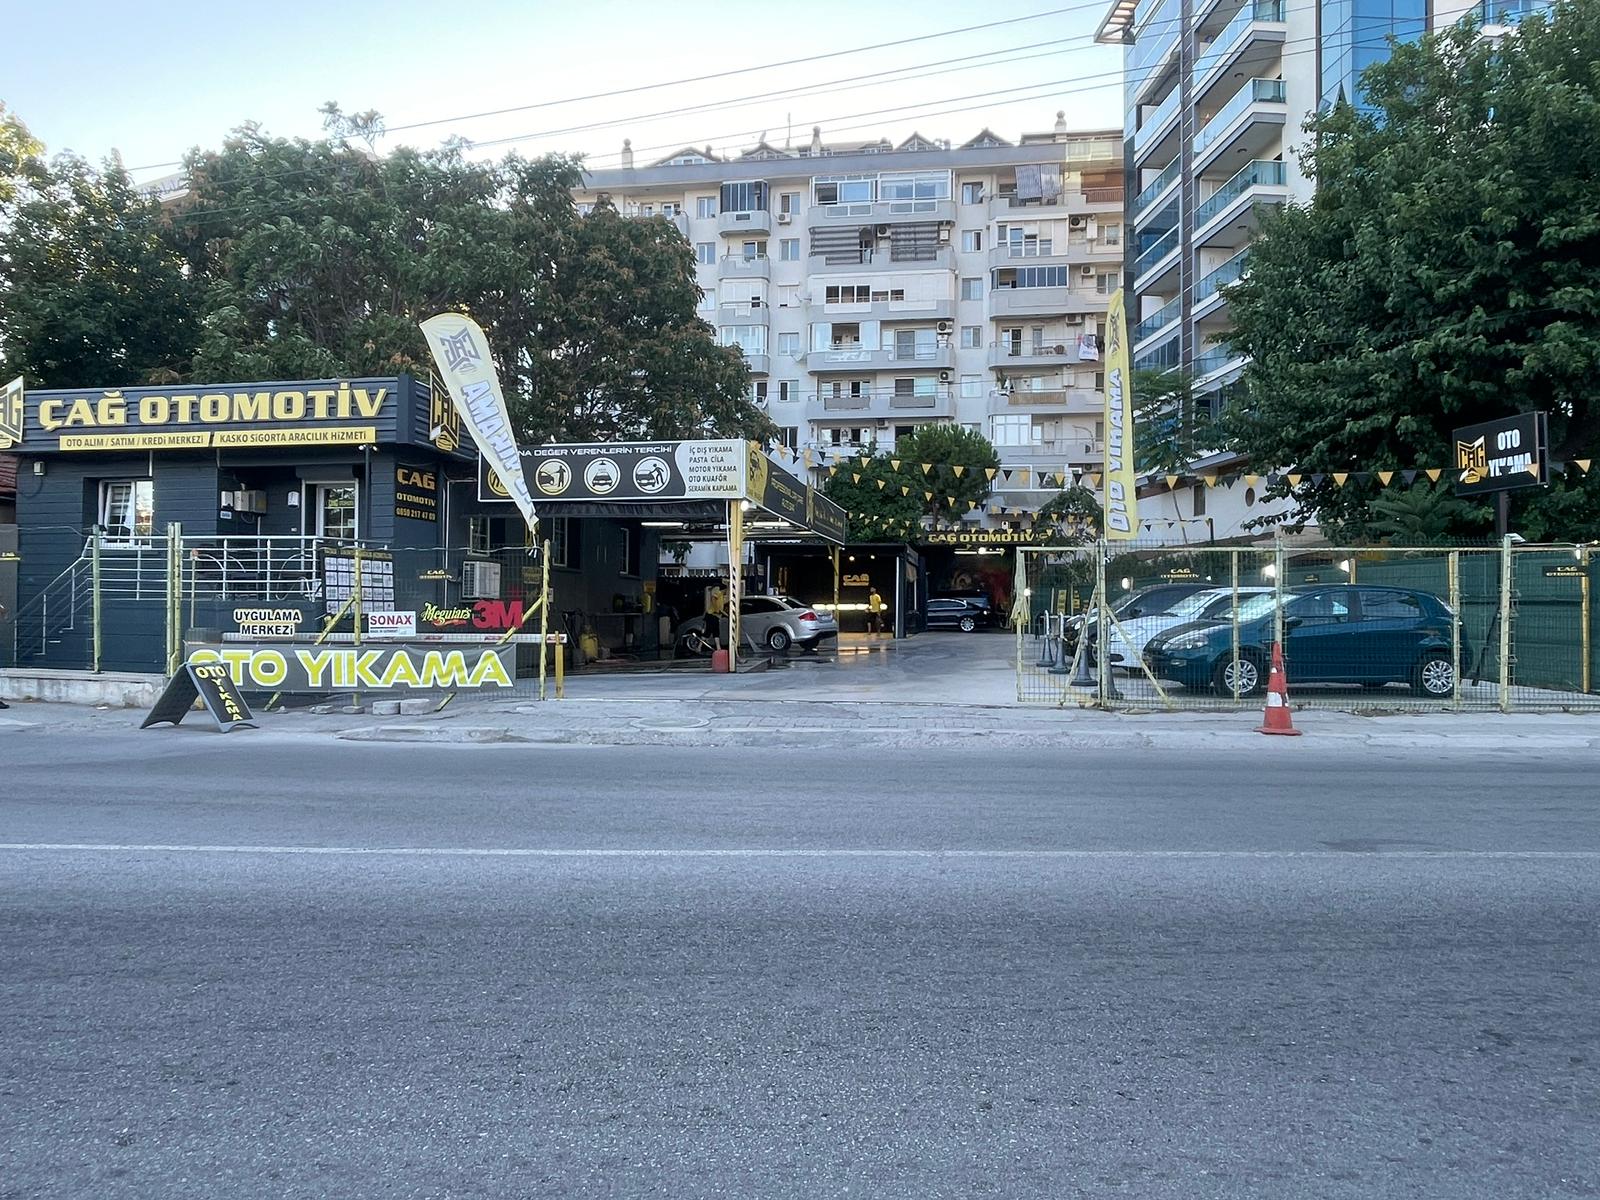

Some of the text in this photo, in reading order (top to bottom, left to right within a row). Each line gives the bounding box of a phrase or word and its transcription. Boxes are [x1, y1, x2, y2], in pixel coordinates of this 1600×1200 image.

[38, 390, 127, 431] ÇAĞ
[139, 382, 387, 424] OTOMOTİV
[66, 436, 82, 447] OTO
[84, 435, 104, 447] ALIM
[111, 435, 135, 446] SATIM
[219, 432, 248, 443] KASKO
[289, 430, 328, 442] ARACILIK
[1497, 429, 1521, 450] OTO
[534, 448, 568, 457] DEĞER
[569, 446, 633, 456] VERENLERİN
[634, 444, 672, 454] TERCİHİ
[689, 455, 724, 464] PASTA CİLA
[688, 465, 711, 473] MOTOR
[396, 468, 436, 490] ÇAĞ
[688, 473, 728, 483] OTO KUAFÖR
[712, 484, 738, 492] KAPLAMA
[235, 610, 301, 622] UYGULAMA
[370, 615, 412, 626] SONAX
[472, 600, 523, 629] 3M
[195, 665, 227, 679] OTO
[294, 648, 514, 689] YIKAMA
[211, 678, 243, 721] YIKAMA
